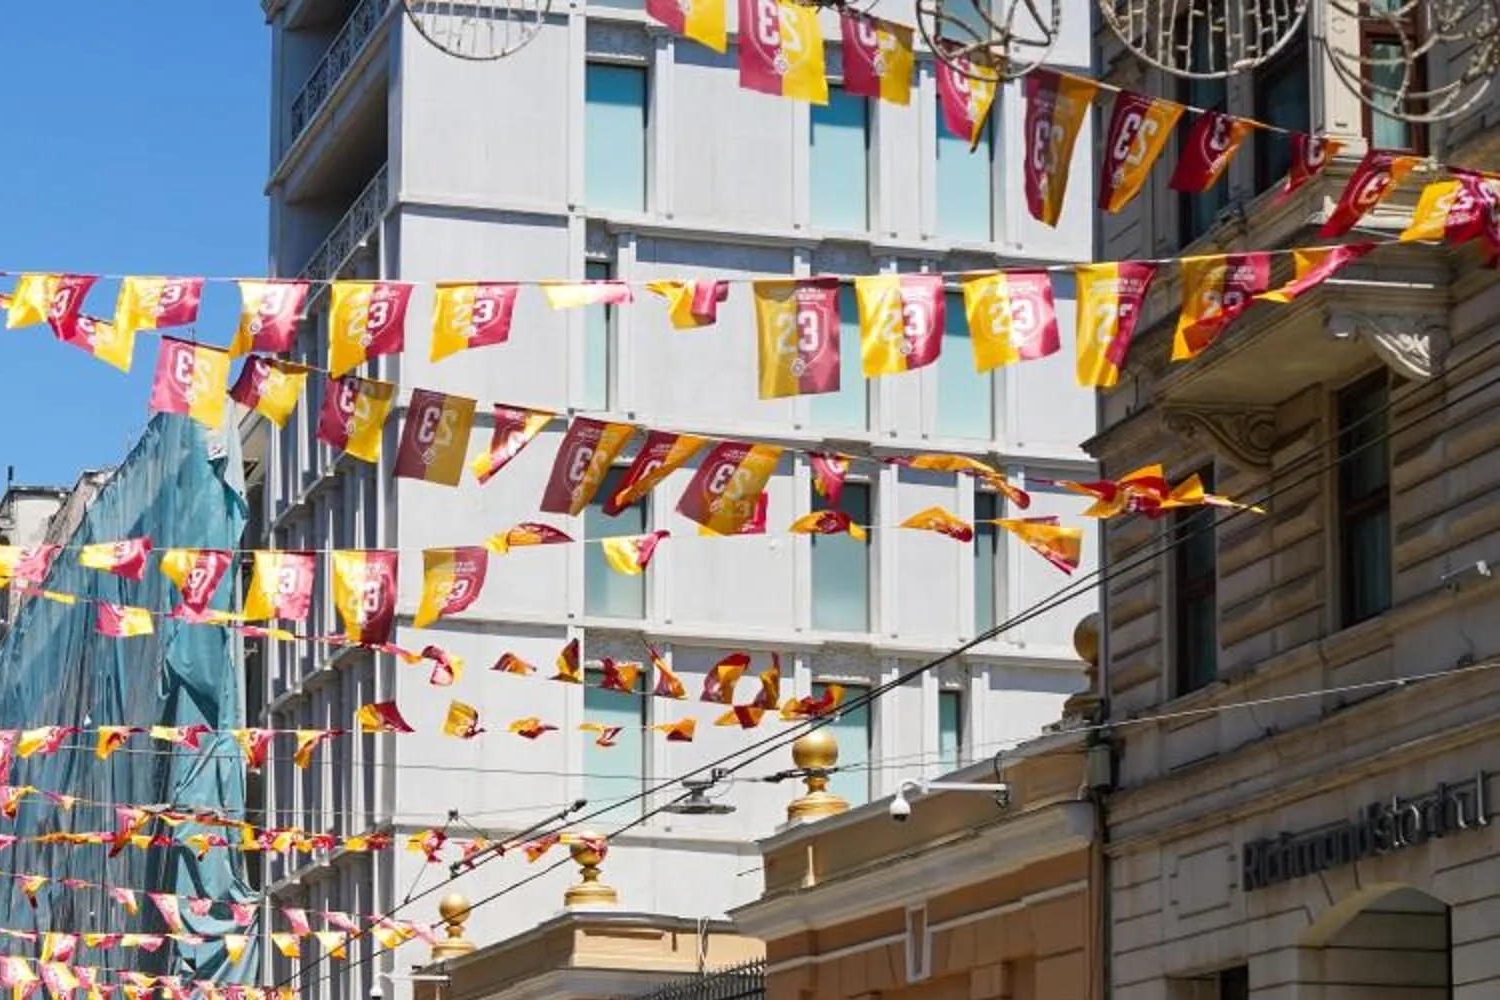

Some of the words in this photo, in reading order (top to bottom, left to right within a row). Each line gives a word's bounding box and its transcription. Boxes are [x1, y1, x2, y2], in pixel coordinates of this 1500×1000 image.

[348, 302, 389, 336] 23
[452, 299, 495, 327] 23
[775, 309, 820, 353] 23
[881, 303, 926, 340] 23
[988, 298, 1036, 335] 23
